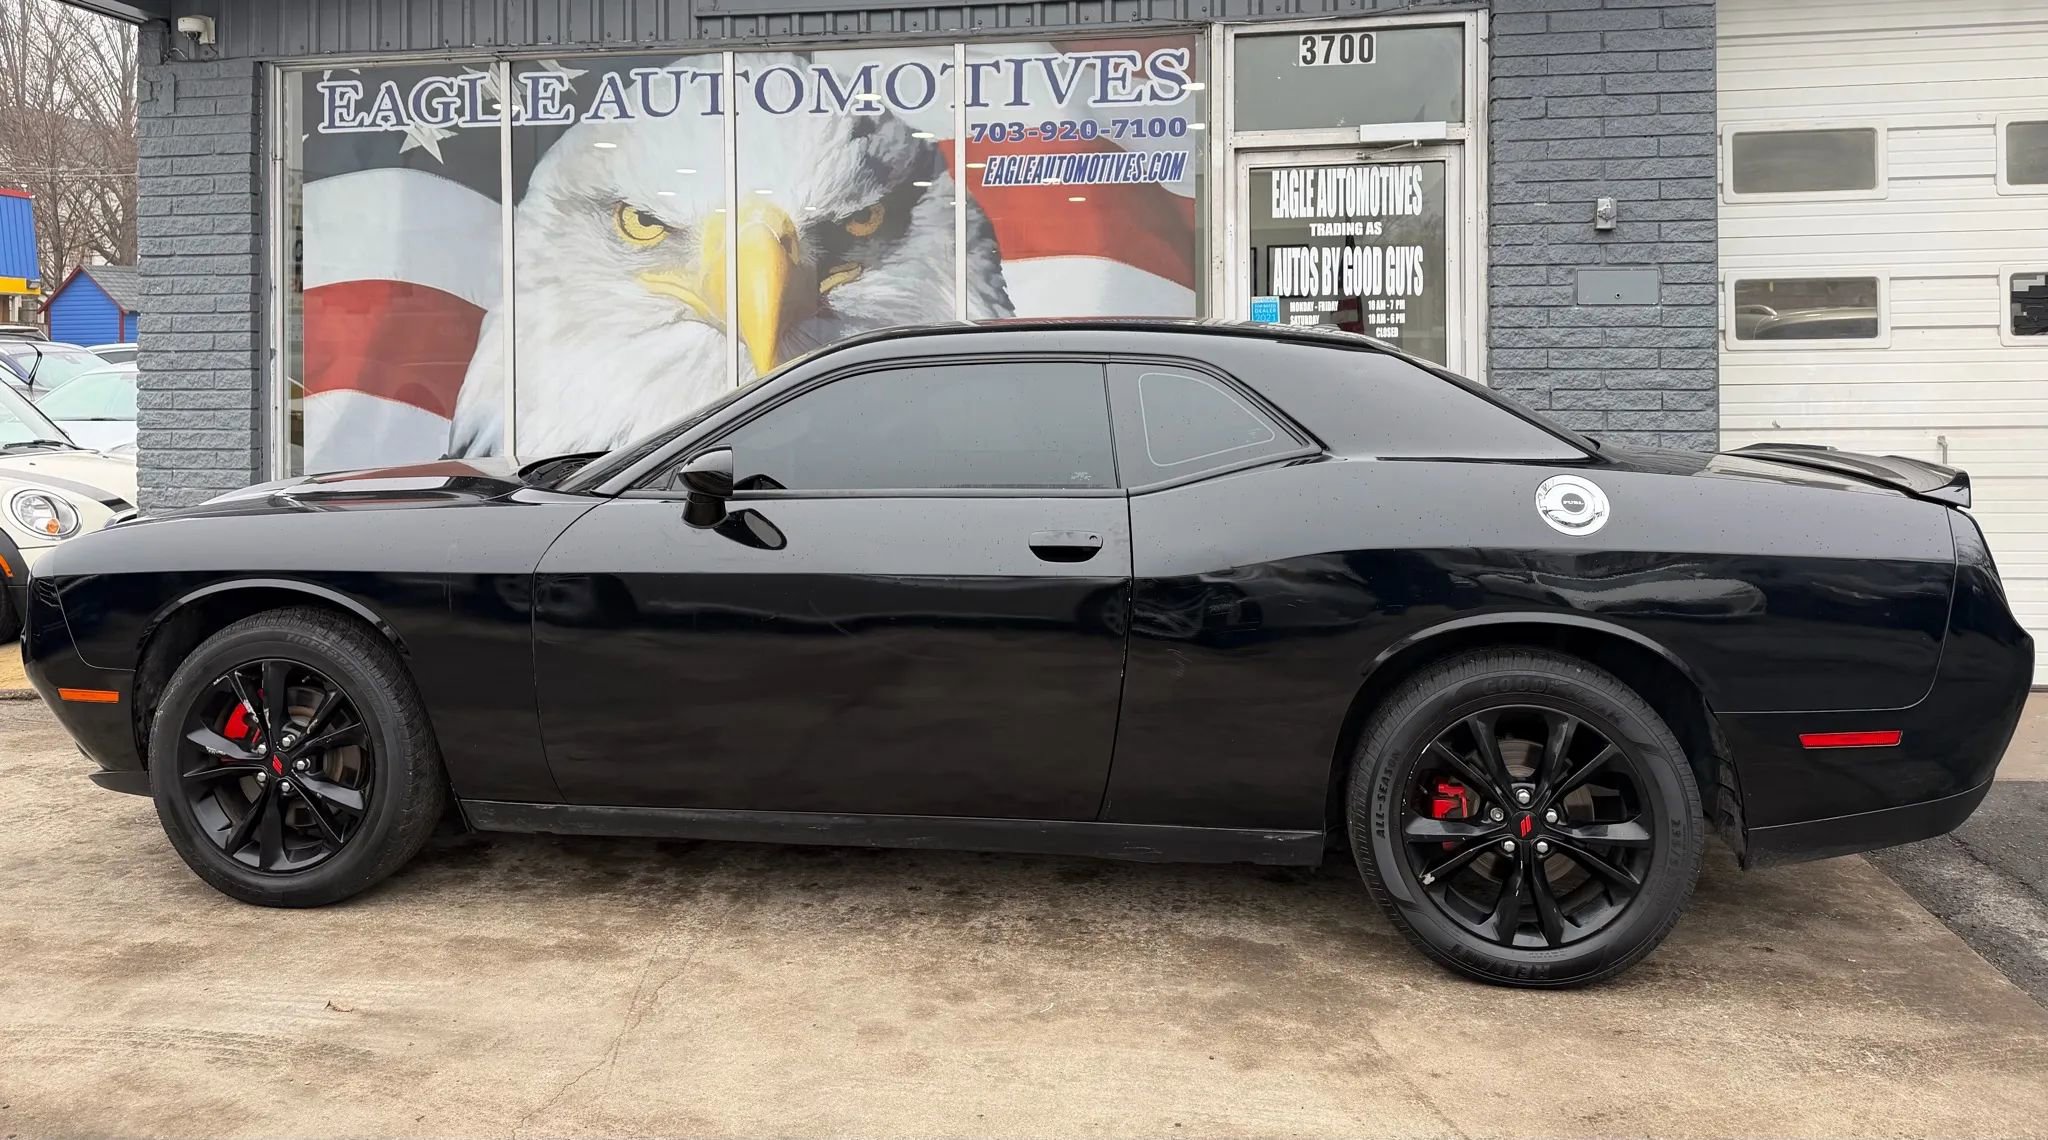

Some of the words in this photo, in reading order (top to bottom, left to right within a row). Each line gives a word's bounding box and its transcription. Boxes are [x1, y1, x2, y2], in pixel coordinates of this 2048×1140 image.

[1301, 33, 1374, 65] 3700
[319, 71, 573, 131] EAGLE
[583, 49, 1190, 119] AUTOMOTIVES
[970, 117, 1187, 143] 703-920-7100
[983, 152, 1187, 186] EAGLEAUTOMOTIVES.COM
[1272, 169, 1315, 218] EAGLE
[1317, 165, 1423, 217] AUTOMOTIVES
[1309, 222, 1363, 237] TRADING
[1365, 221, 1383, 236] AS
[1273, 246, 1319, 297] AUTOS
[1322, 246, 1341, 296] BY
[1343, 245, 1383, 297] GOOD
[1385, 245, 1424, 297] GUYS
[1289, 301, 1314, 313] MONDAY
[1318, 300, 1339, 312] FRIDAY
[1376, 299, 1387, 311] AM
[1395, 299, 1406, 310] PM
[1289, 314, 1320, 326] SATURDAY
[1376, 313, 1387, 324] AM
[1395, 312, 1406, 324] PM
[1375, 326, 1399, 338] CLOSED
